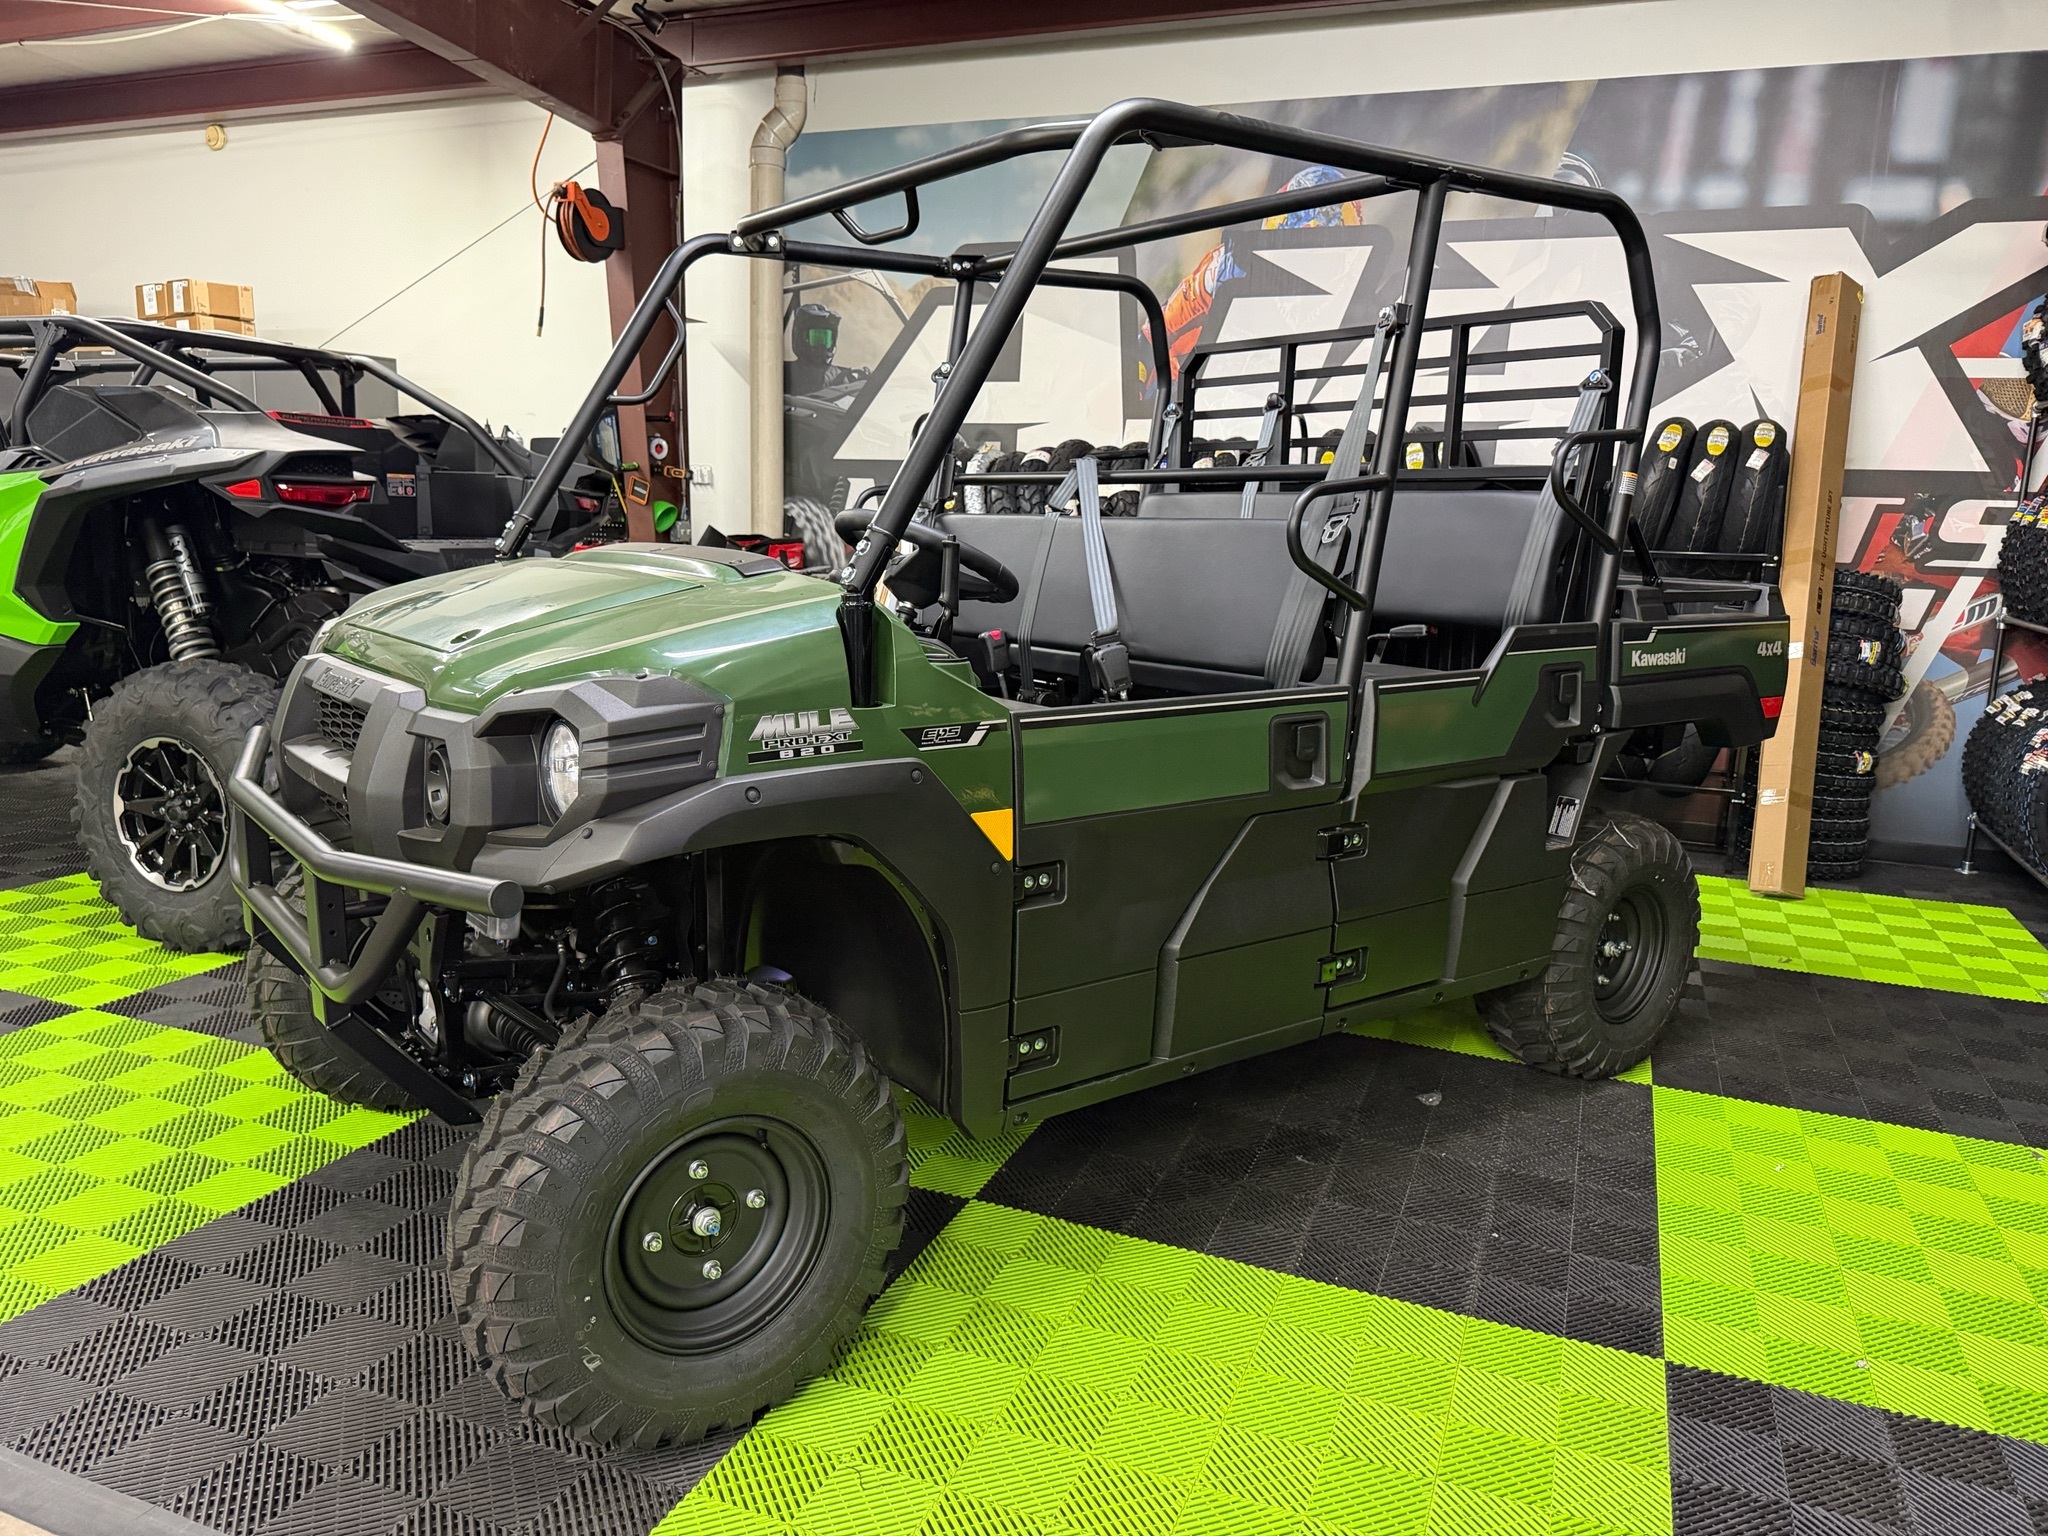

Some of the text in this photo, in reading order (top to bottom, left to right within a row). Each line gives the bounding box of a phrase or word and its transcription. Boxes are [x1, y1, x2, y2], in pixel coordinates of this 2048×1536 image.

[64, 435, 200, 470] Kawasaki
[1631, 648, 1687, 667] Kawasaki
[1757, 641, 1783, 657] 4x4
[748, 708, 860, 741] MULE
[922, 726, 962, 742] EPS
